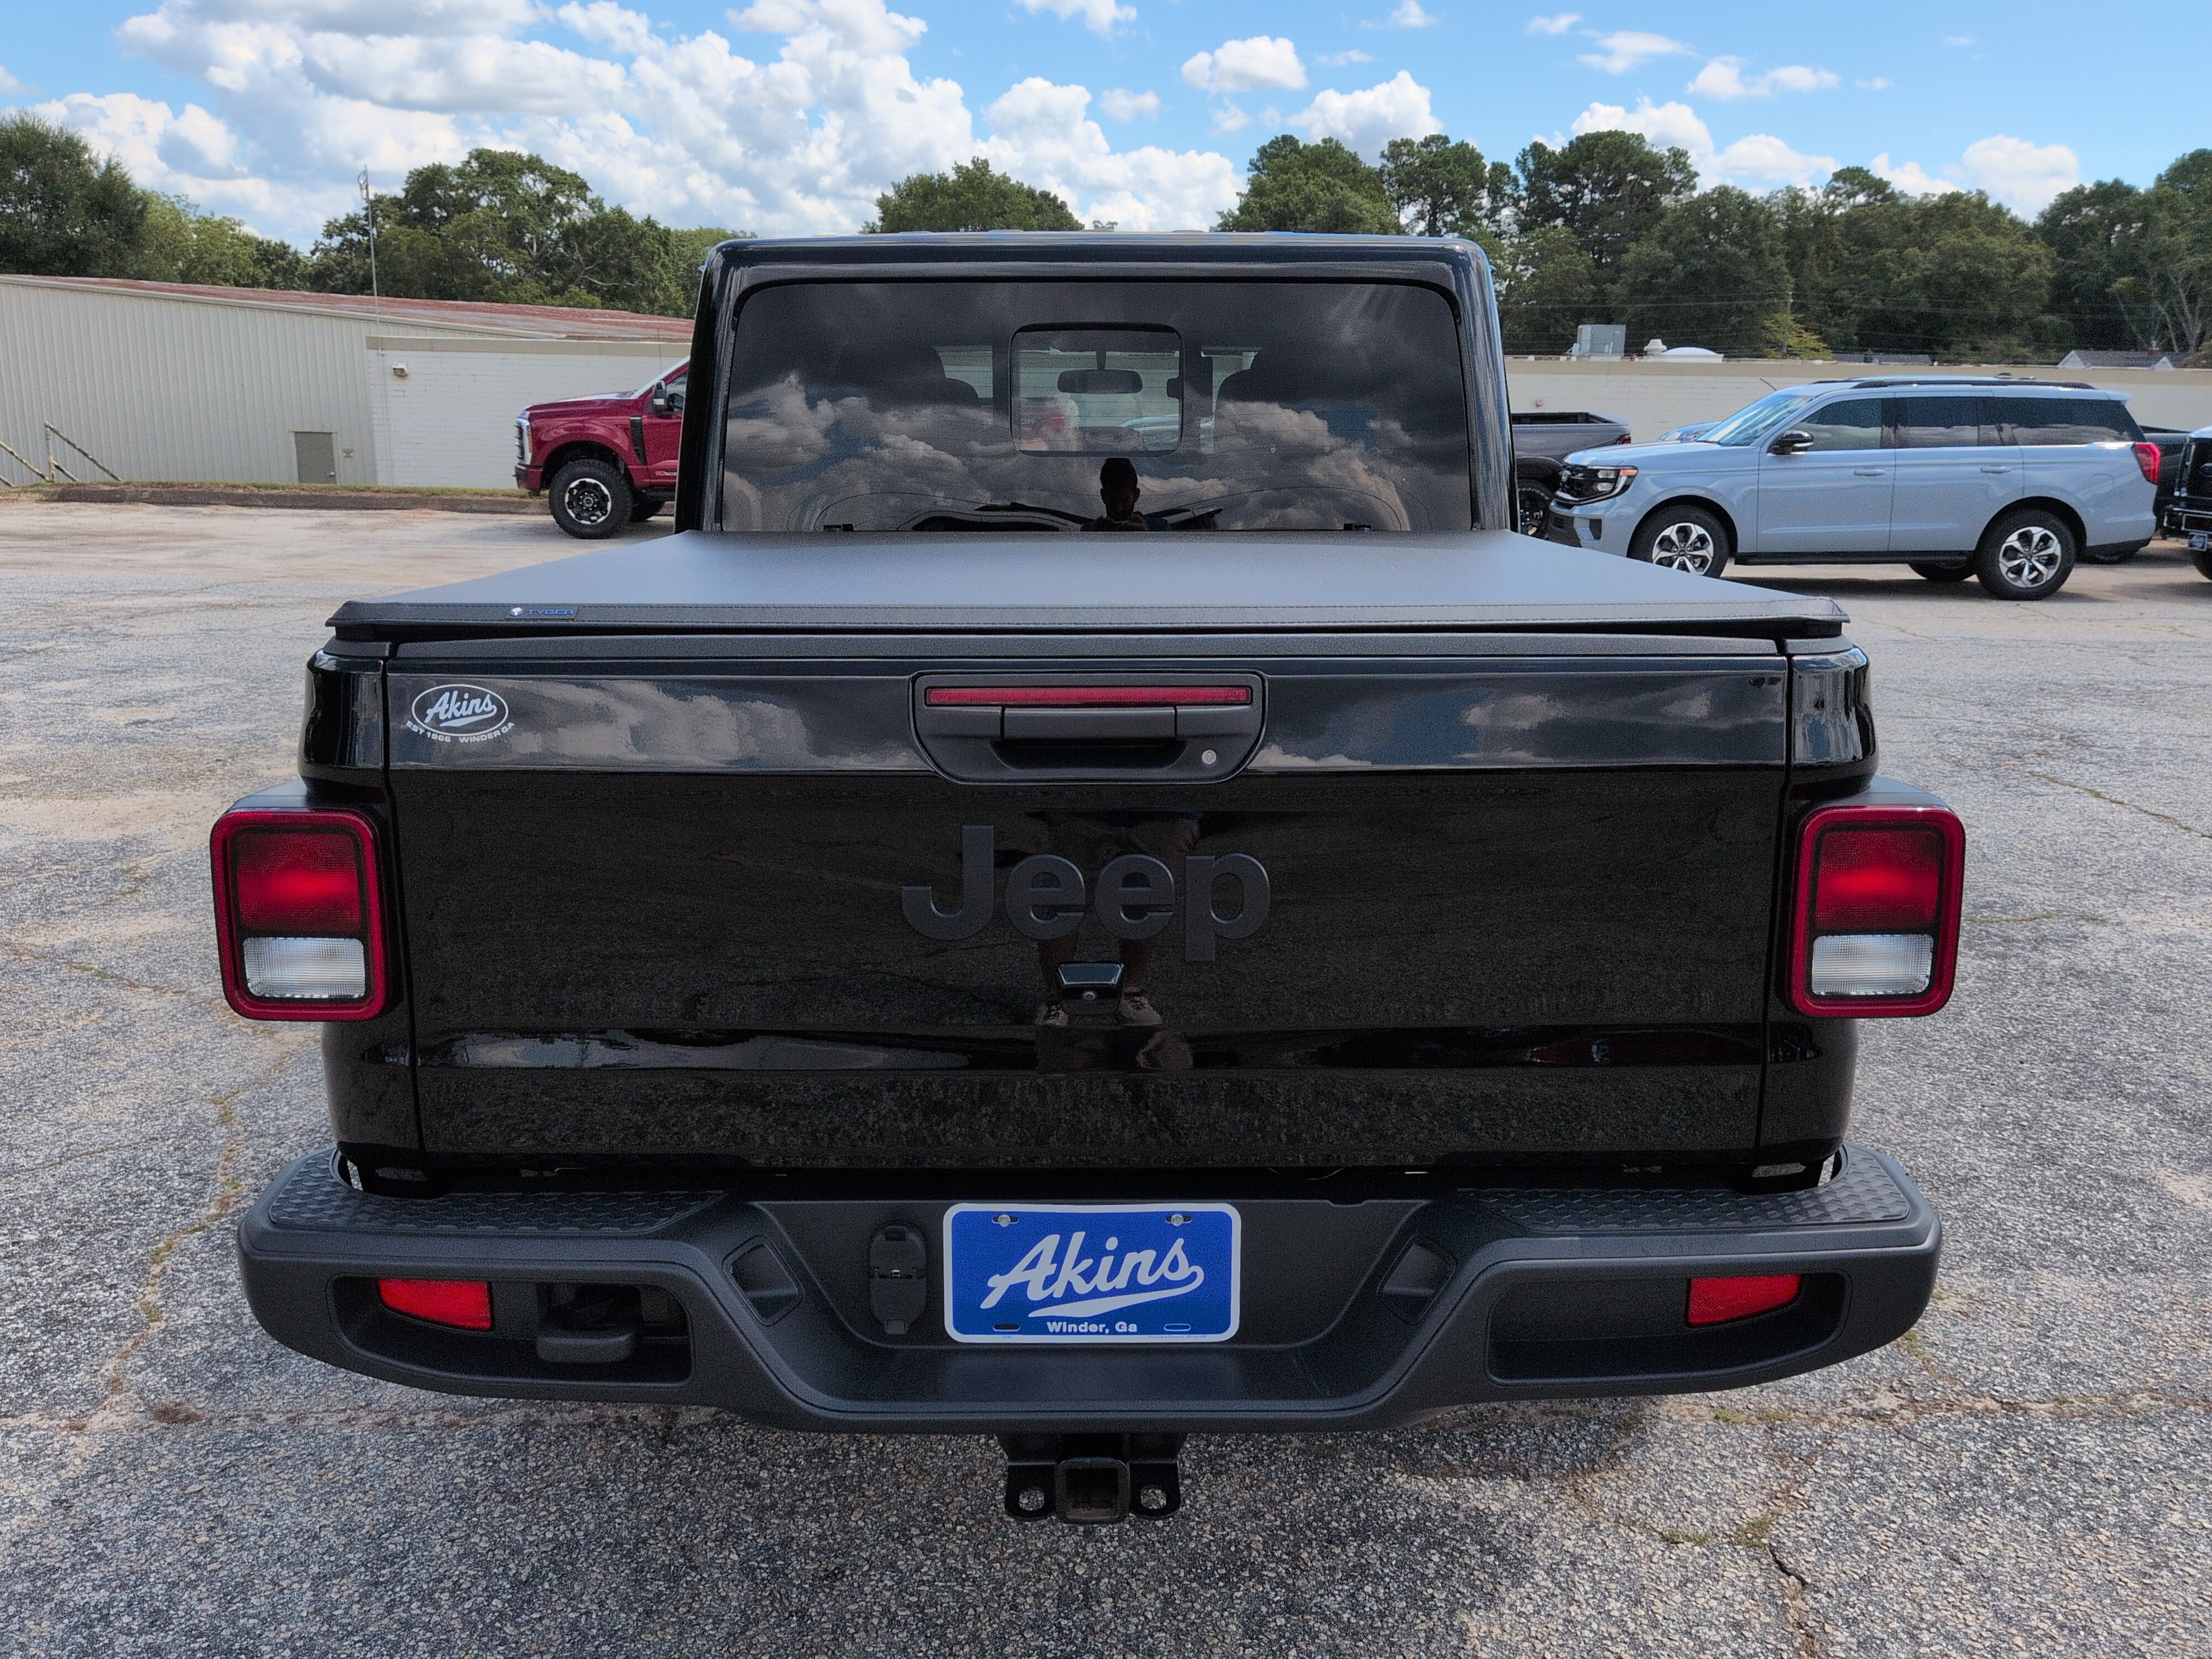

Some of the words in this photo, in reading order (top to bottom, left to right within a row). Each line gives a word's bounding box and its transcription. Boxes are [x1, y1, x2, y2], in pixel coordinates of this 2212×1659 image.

[424, 691, 497, 726] Akins
[406, 720, 425, 735] EST
[426, 732, 451, 742] 1966
[459, 730, 501, 743] WINDER
[501, 722, 515, 733] GA
[901, 825, 1271, 961] Jeep
[980, 1232, 1204, 1317] Akins
[1046, 1321, 1109, 1334] Winder,
[1115, 1321, 1138, 1332] Ga
